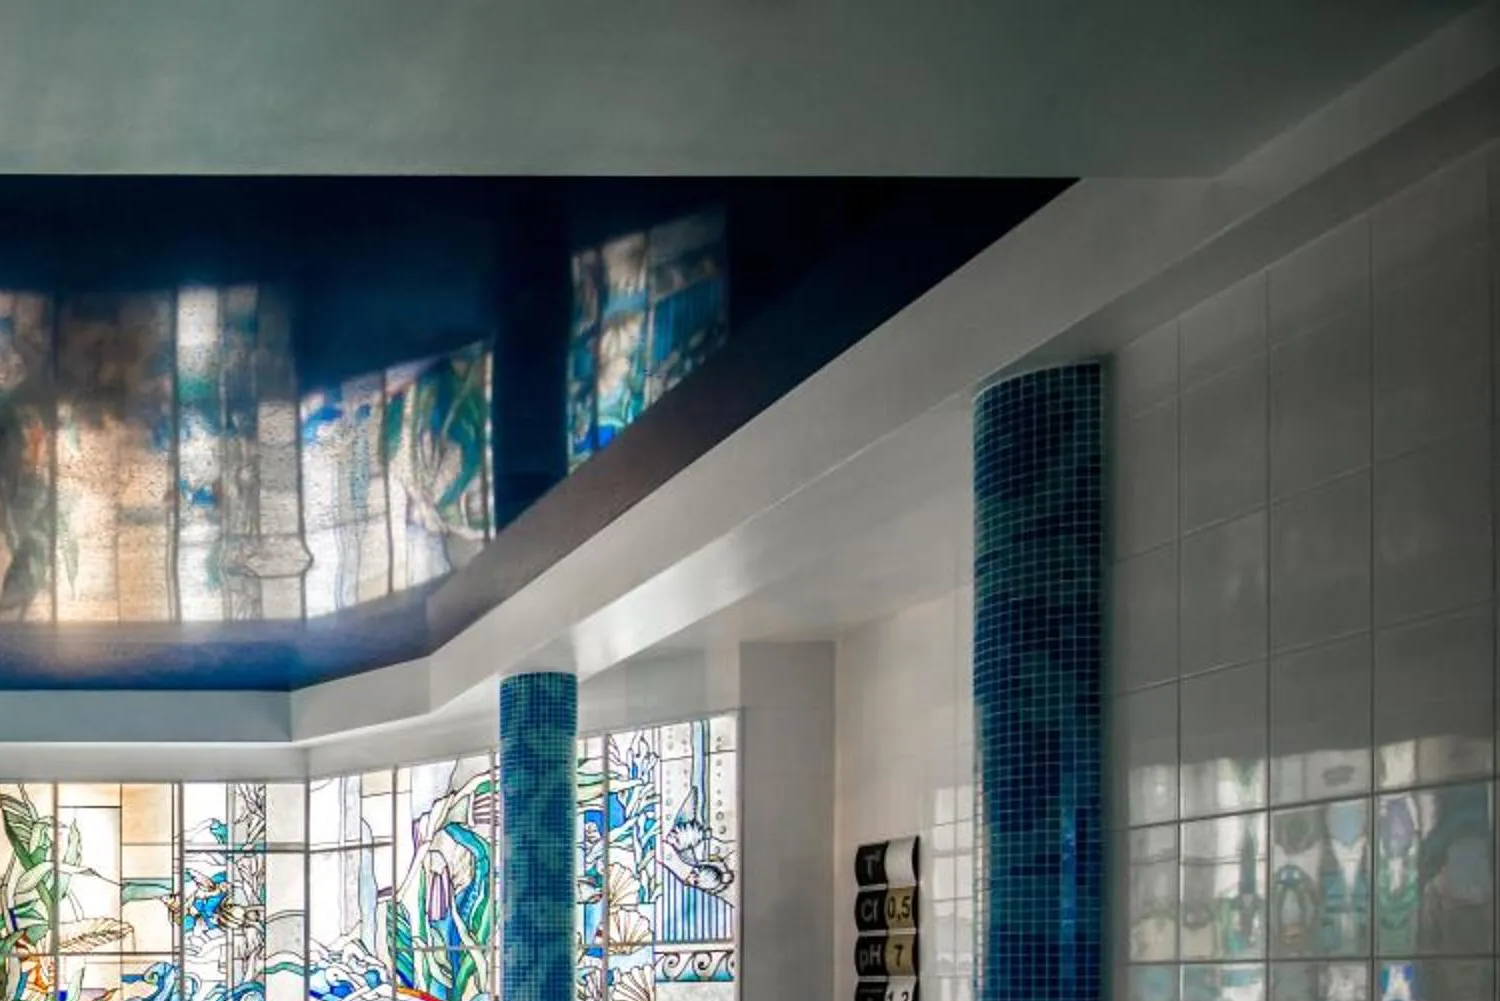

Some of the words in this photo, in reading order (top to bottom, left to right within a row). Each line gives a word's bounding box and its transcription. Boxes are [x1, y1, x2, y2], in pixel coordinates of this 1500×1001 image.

[887, 895, 911, 921] 0,5
[858, 943, 882, 972] pH
[893, 943, 904, 968] 7
